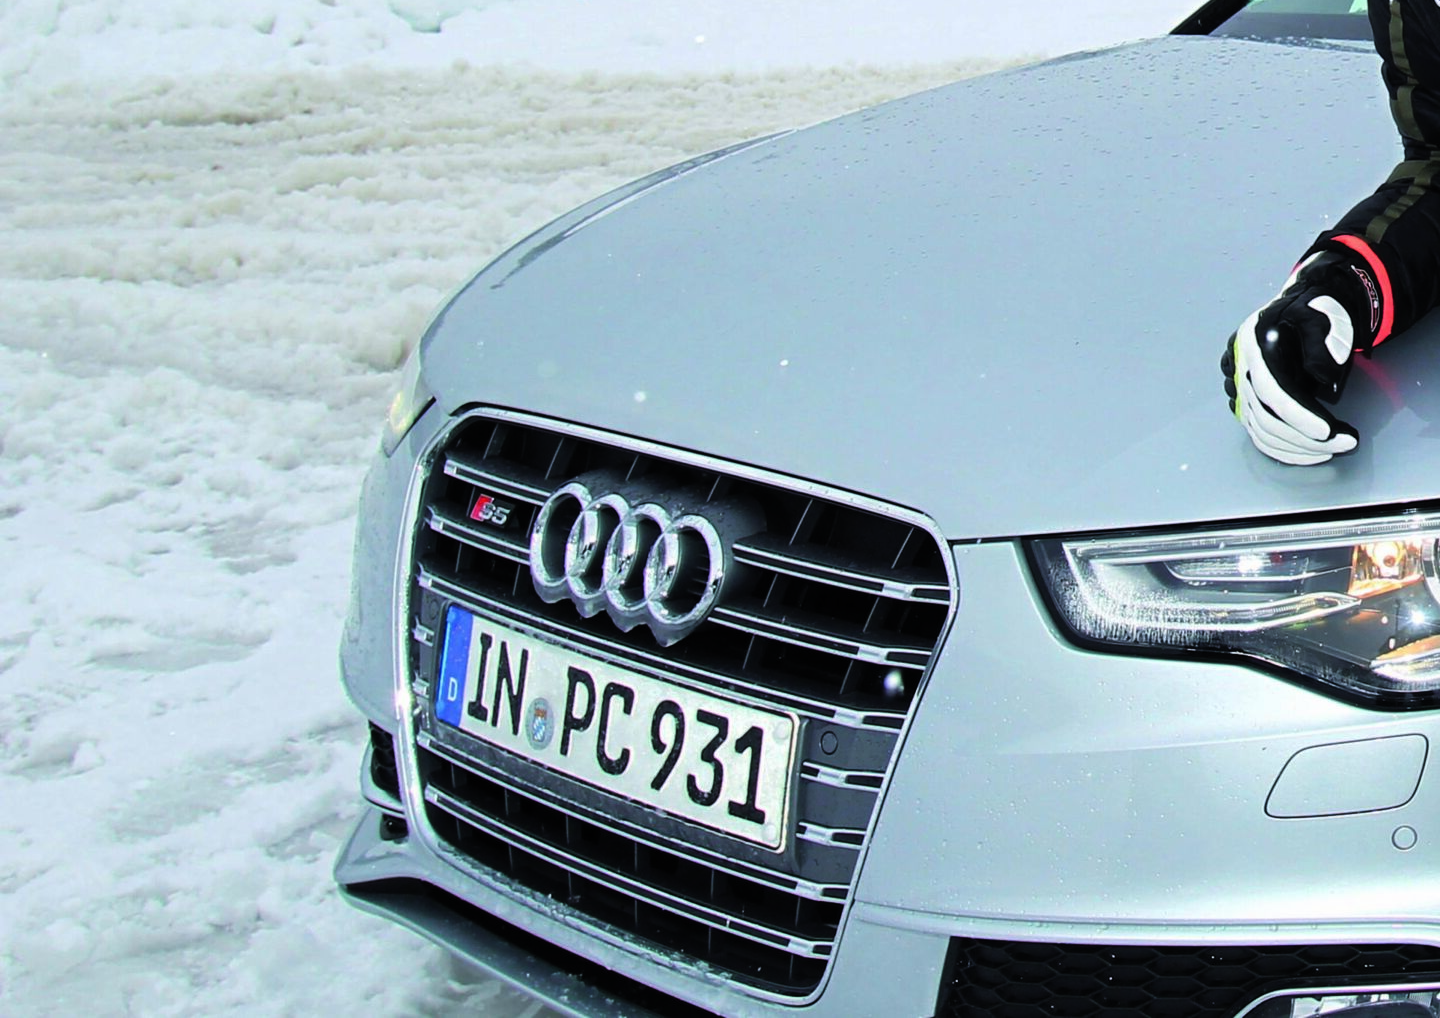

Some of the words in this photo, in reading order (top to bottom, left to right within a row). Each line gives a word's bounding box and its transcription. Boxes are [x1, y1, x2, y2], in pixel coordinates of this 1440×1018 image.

[479, 502, 511, 525] S5
[448, 677, 458, 702] D
[467, 632, 529, 736] IN
[560, 666, 636, 775] PC
[651, 700, 766, 825] 931
